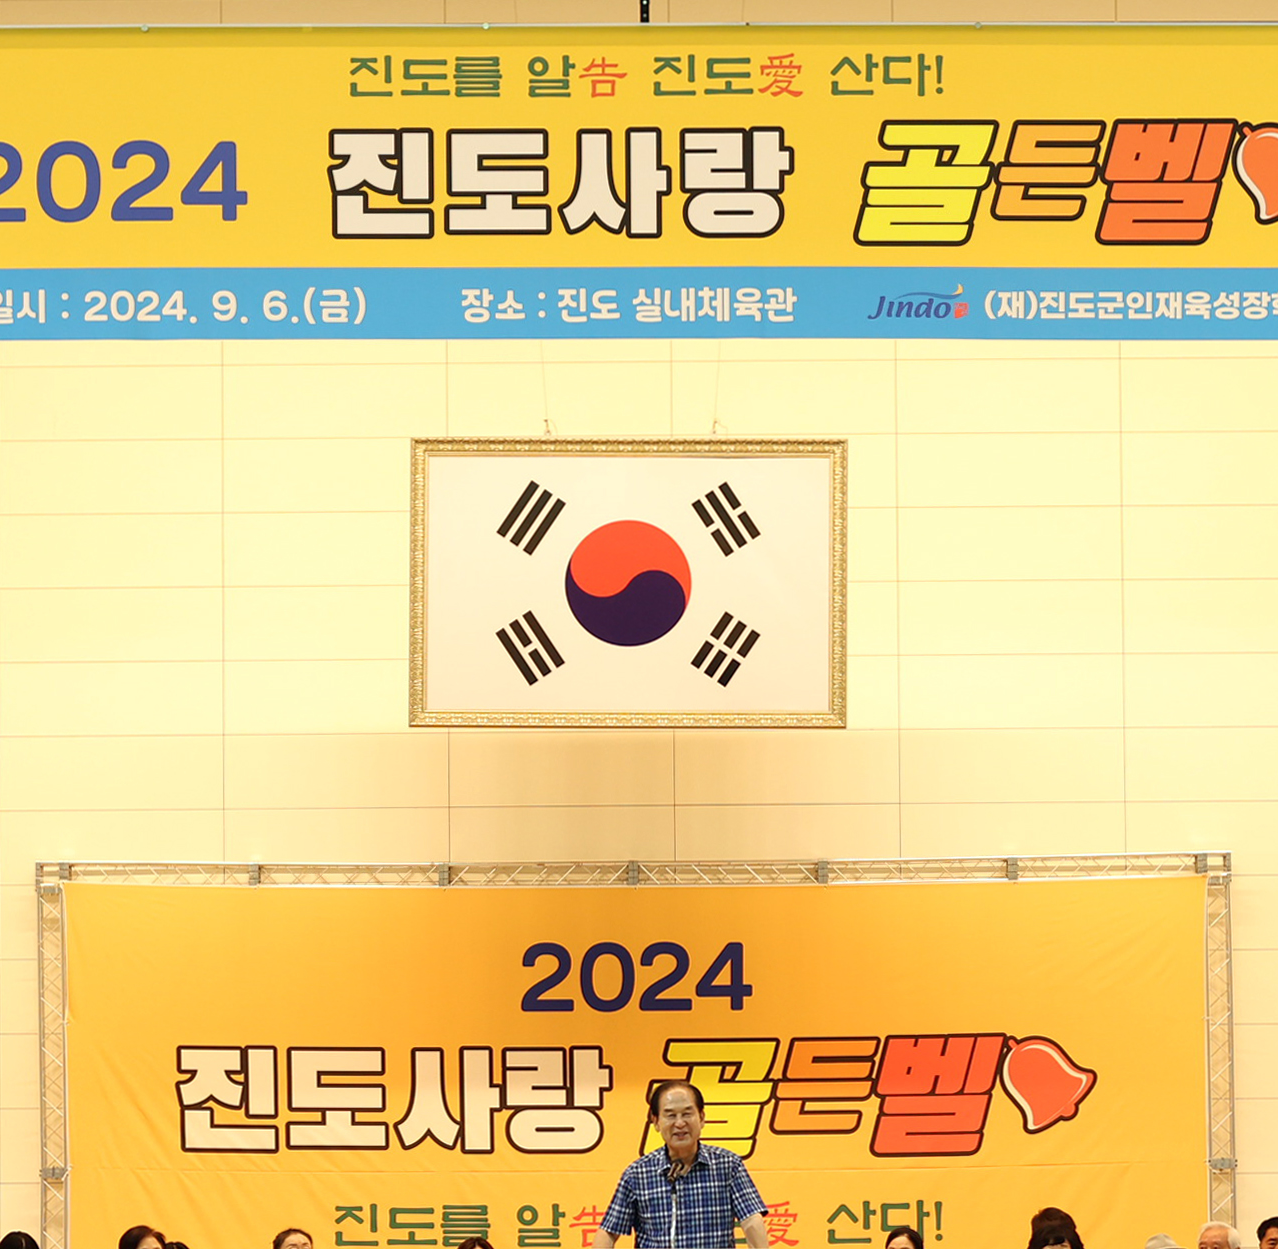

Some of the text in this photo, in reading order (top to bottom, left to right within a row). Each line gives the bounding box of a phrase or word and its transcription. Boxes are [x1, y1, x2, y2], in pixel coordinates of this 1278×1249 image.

[349, 53, 944, 98] 진도를 알告 진도愛 산다!
[327, 127, 795, 239] 진도사랑
[853, 118, 1238, 246] 골든벨
[84, 290, 199, 325] 2024.
[212, 290, 250, 325] 9.
[262, 286, 367, 325] 6.(금)
[461, 288, 527, 324] 장소
[558, 288, 621, 323] 진도
[632, 287, 798, 323] 실내체육관
[867, 295, 952, 320] Jindo
[521, 941, 753, 1013] 2024
[175, 1033, 1007, 1159] 진도사랑 골든벨
[334, 1201, 491, 1248] 진도를
[826, 1200, 944, 1245] 산다!
